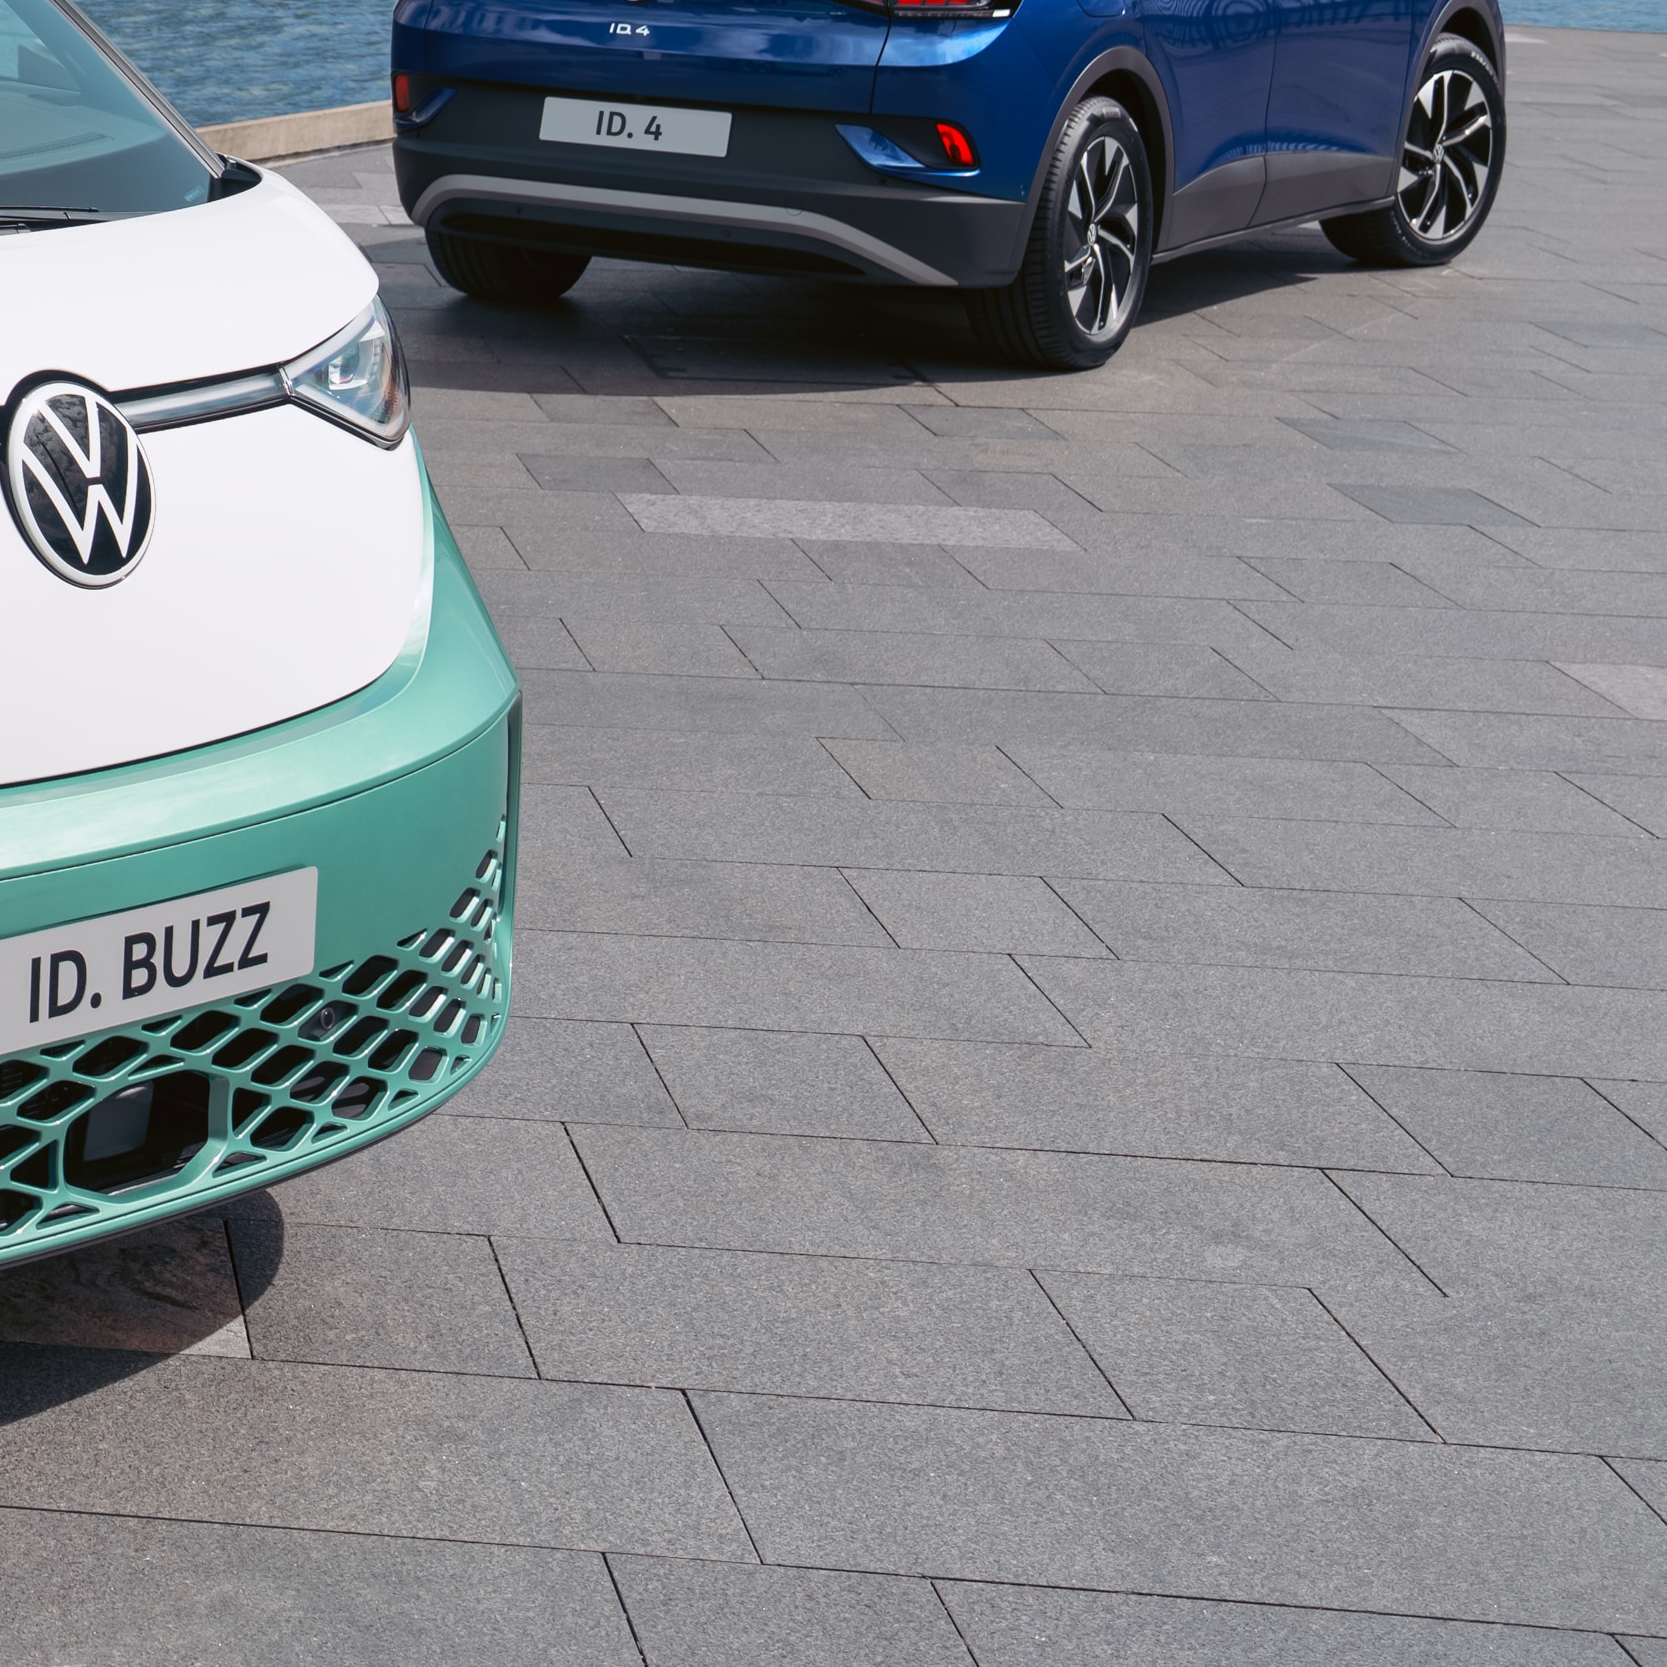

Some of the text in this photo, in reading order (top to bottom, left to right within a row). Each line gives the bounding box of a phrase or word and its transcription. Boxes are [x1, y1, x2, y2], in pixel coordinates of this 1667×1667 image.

[595, 110, 663, 141] ID. 4
[8, 381, 156, 586] VW
[29, 900, 271, 1024] ID. BUZZ
